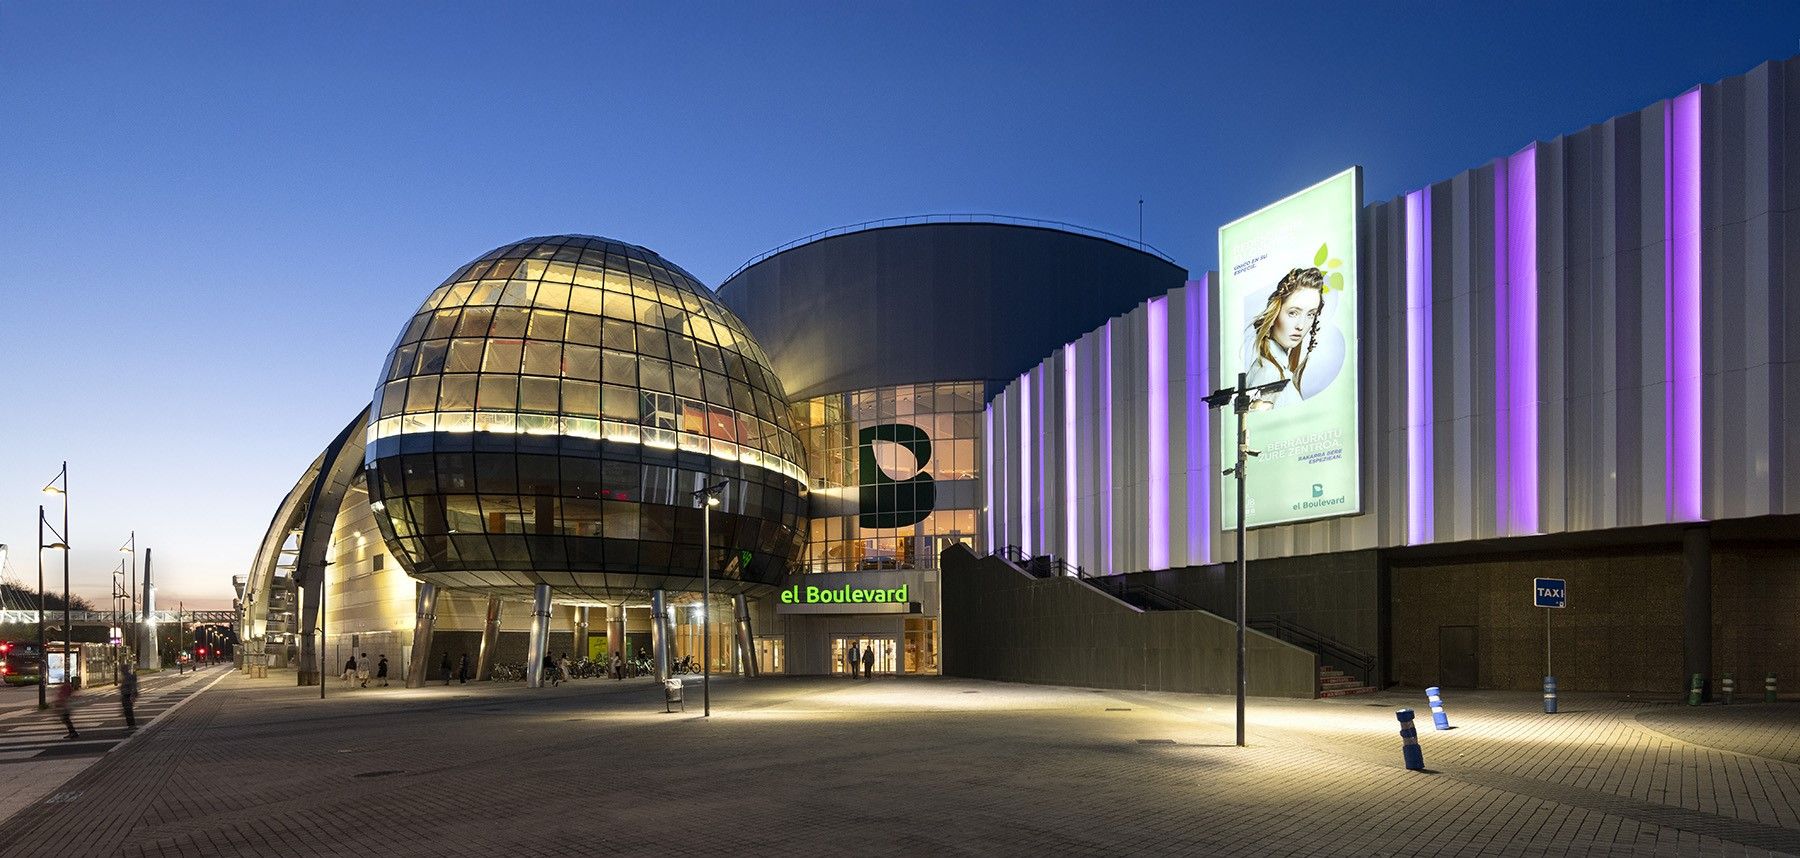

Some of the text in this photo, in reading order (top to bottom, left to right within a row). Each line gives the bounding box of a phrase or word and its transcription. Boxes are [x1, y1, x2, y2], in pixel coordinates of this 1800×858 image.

[1267, 429, 1342, 452] BERRAURKITU
[1292, 496, 1345, 511] el Boulevard
[780, 584, 909, 604] el Boulevard
[1537, 588, 1564, 598] TAXI
